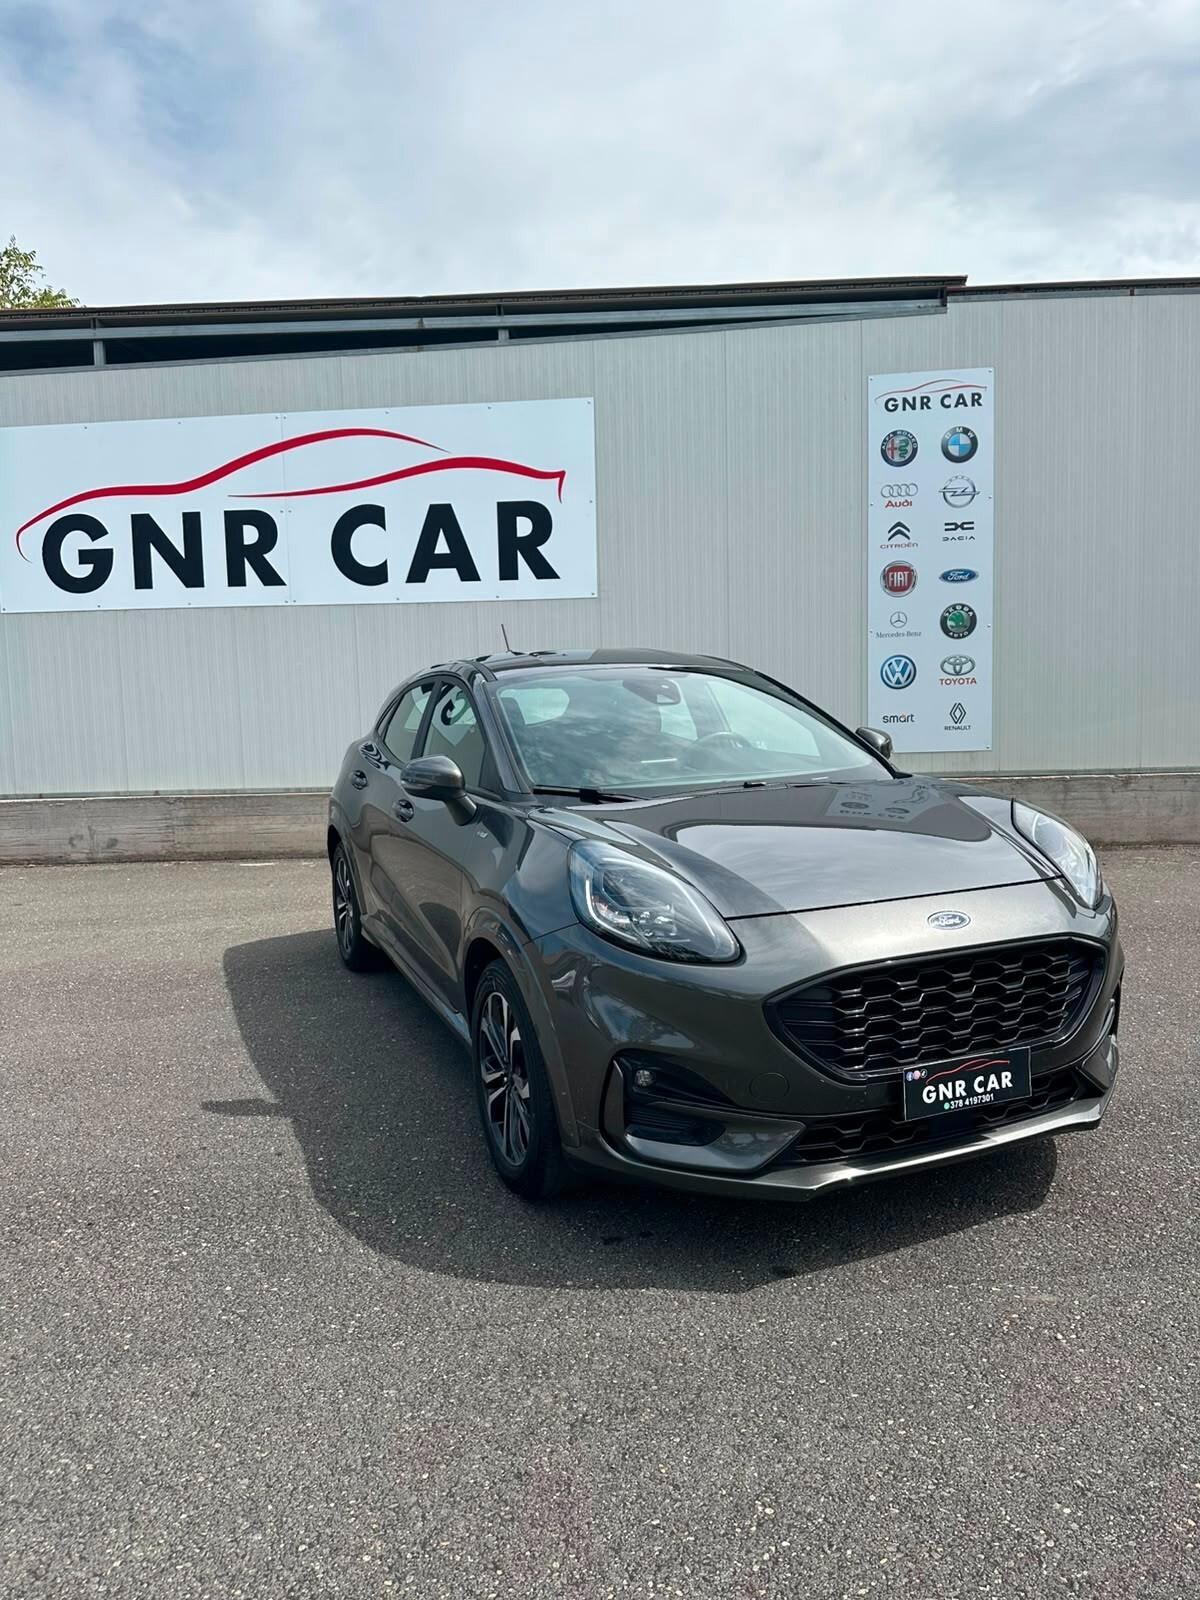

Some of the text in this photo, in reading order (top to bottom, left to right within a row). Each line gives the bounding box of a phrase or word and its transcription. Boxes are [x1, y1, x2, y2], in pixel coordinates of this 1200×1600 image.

[884, 392, 983, 413] GNR CAR
[885, 500, 913, 508] Audi
[41, 500, 561, 594] GNR CAR
[888, 571, 910, 587] FIAT
[947, 570, 970, 582] Ford
[940, 677, 977, 686] TOYOTA
[882, 714, 914, 724] smart
[922, 1071, 1013, 1104] GNR CAR
[950, 1093, 994, 1109] 378 4197301
